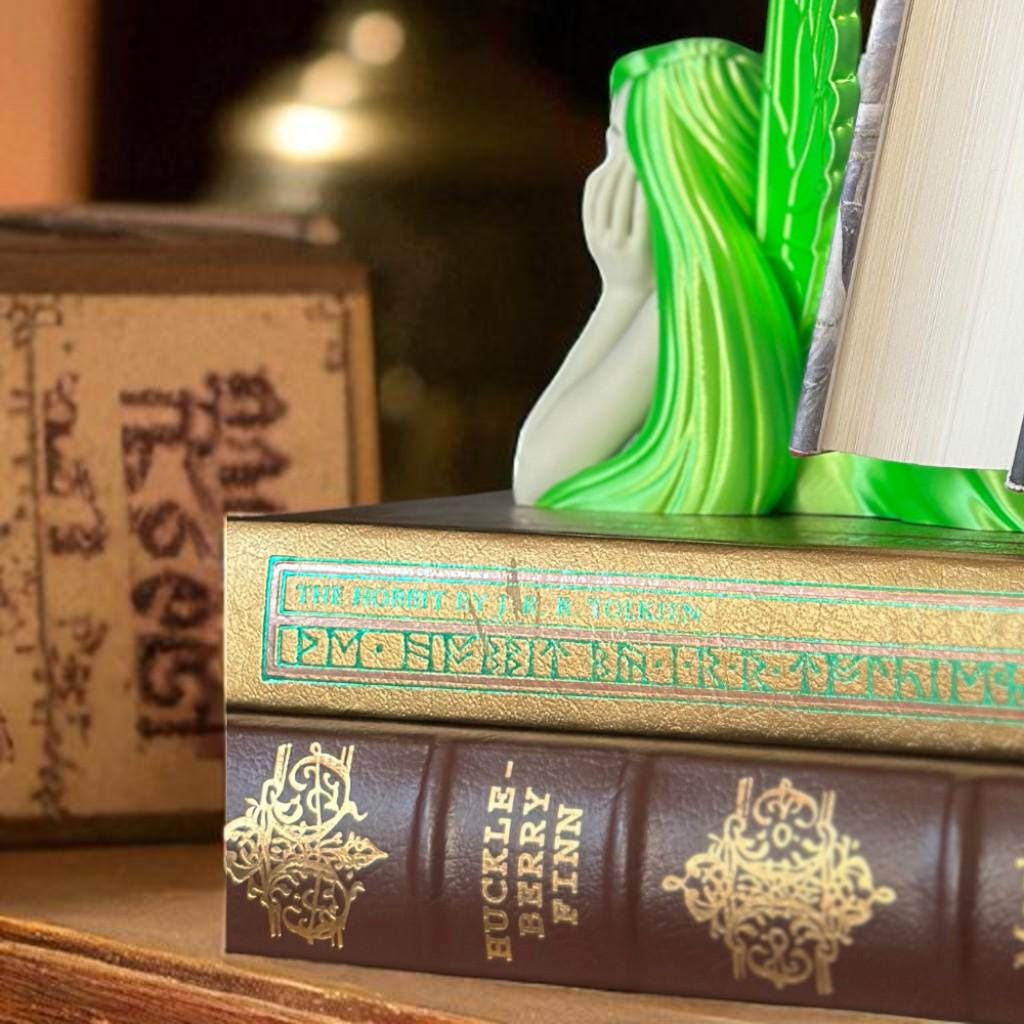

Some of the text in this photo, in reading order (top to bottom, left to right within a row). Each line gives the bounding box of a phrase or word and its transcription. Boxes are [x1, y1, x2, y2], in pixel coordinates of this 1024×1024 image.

[296, 584, 344, 606] THE
[516, 786, 551, 938] BERRY
[551, 803, 584, 926] FINN
